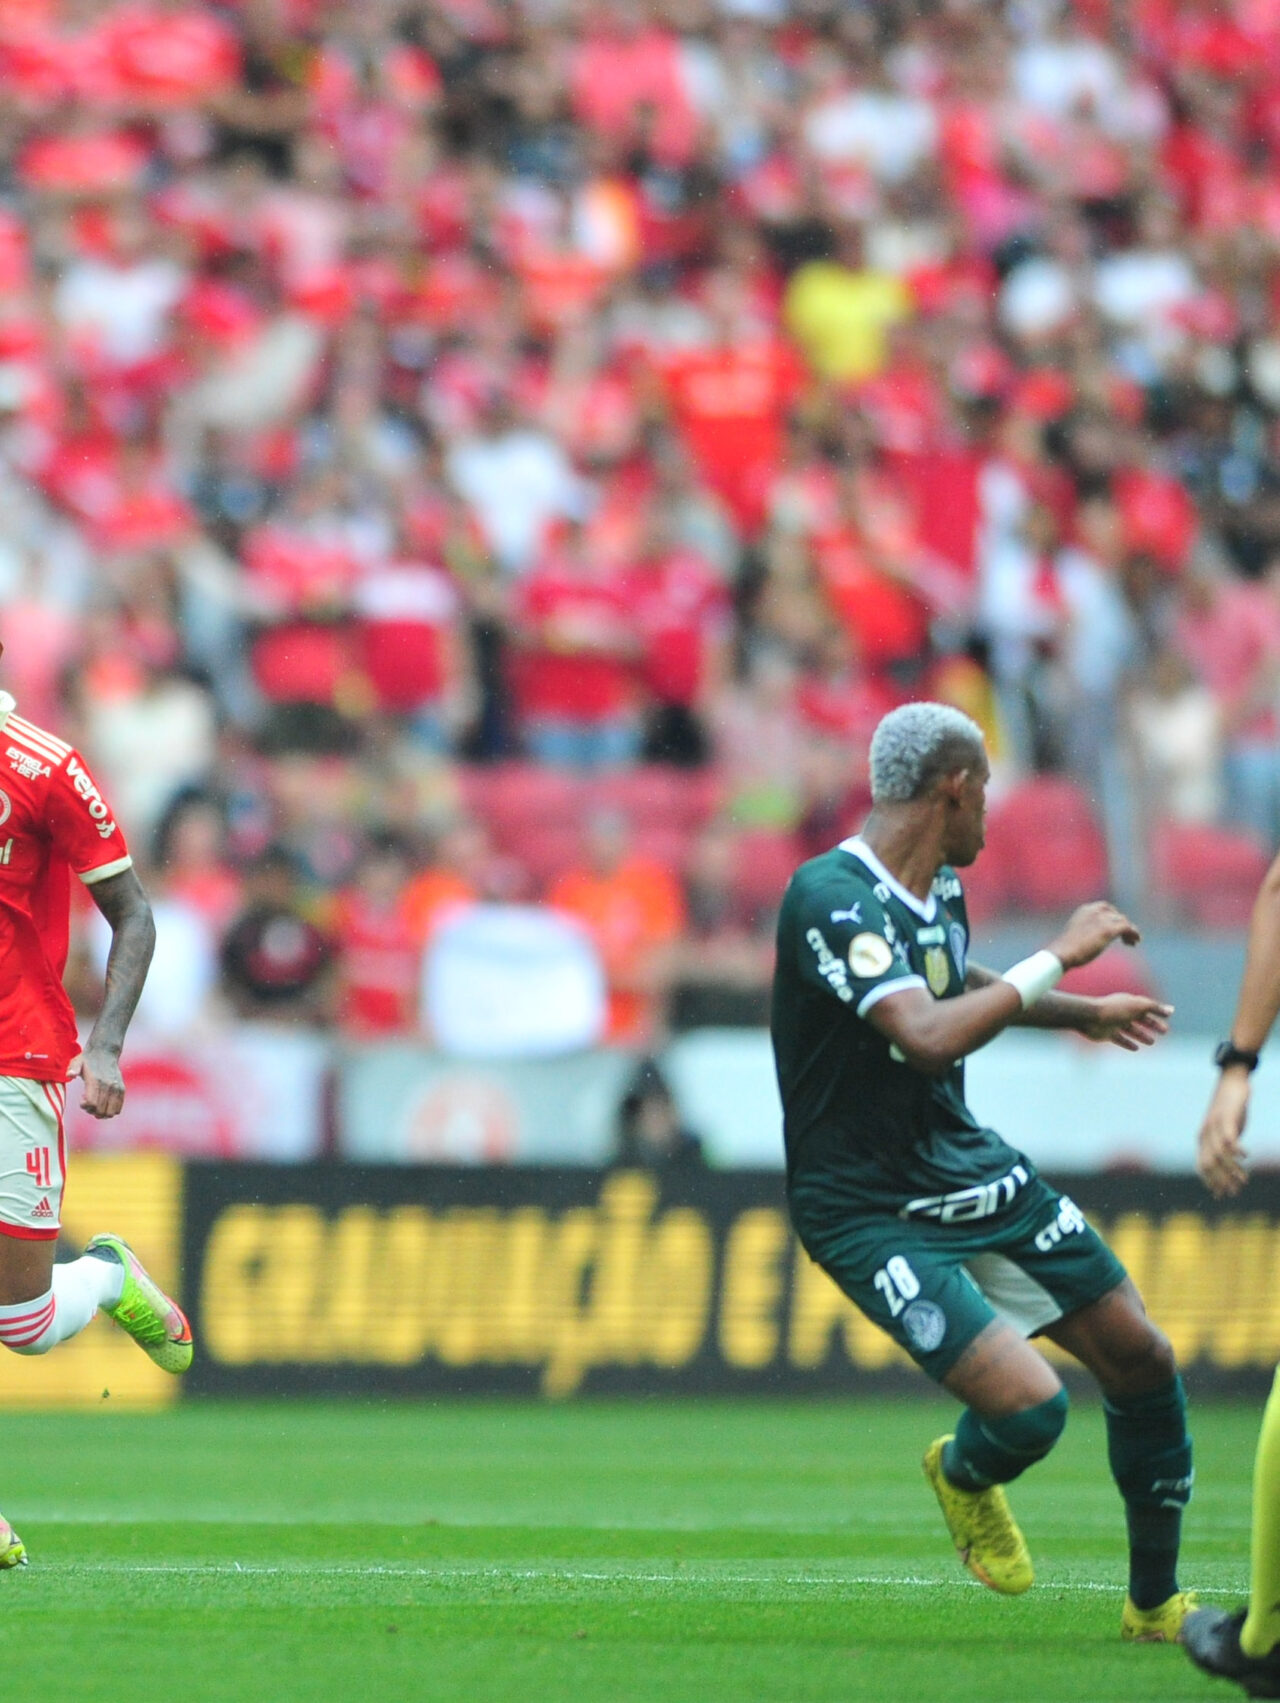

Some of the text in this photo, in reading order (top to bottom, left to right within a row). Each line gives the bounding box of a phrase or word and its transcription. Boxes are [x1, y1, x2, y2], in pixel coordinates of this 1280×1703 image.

[5, 746, 52, 778] ESTRELA
[16, 764, 42, 781] BET
[66, 757, 108, 819] vero
[26, 1146, 51, 1187] 41
[1034, 1194, 1086, 1252] cref
[873, 1254, 920, 1317] 28
